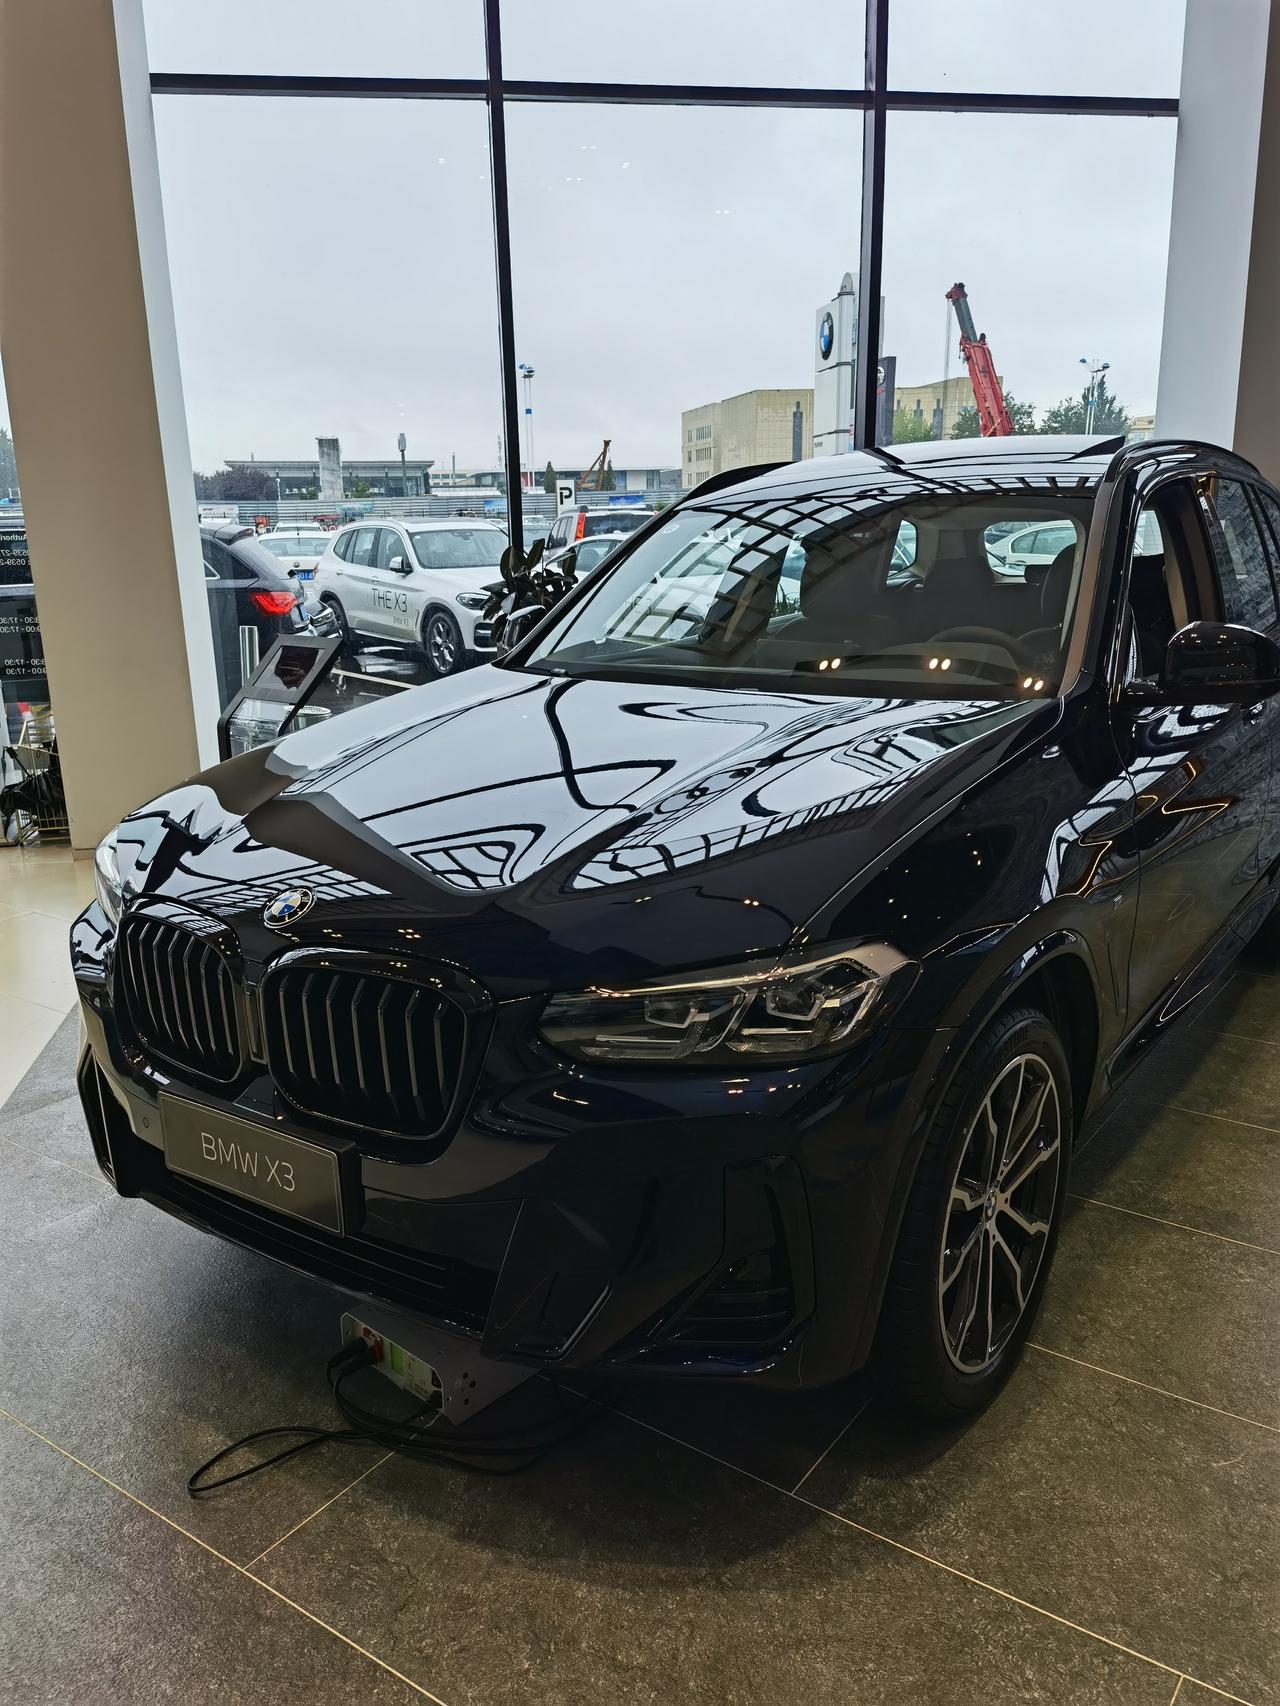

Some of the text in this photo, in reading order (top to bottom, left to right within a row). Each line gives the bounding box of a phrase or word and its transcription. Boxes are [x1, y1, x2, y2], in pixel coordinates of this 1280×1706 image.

[559, 487, 573, 505] P
[371, 587, 408, 613] THE X3
[201, 1132, 295, 1192] BMW X3
